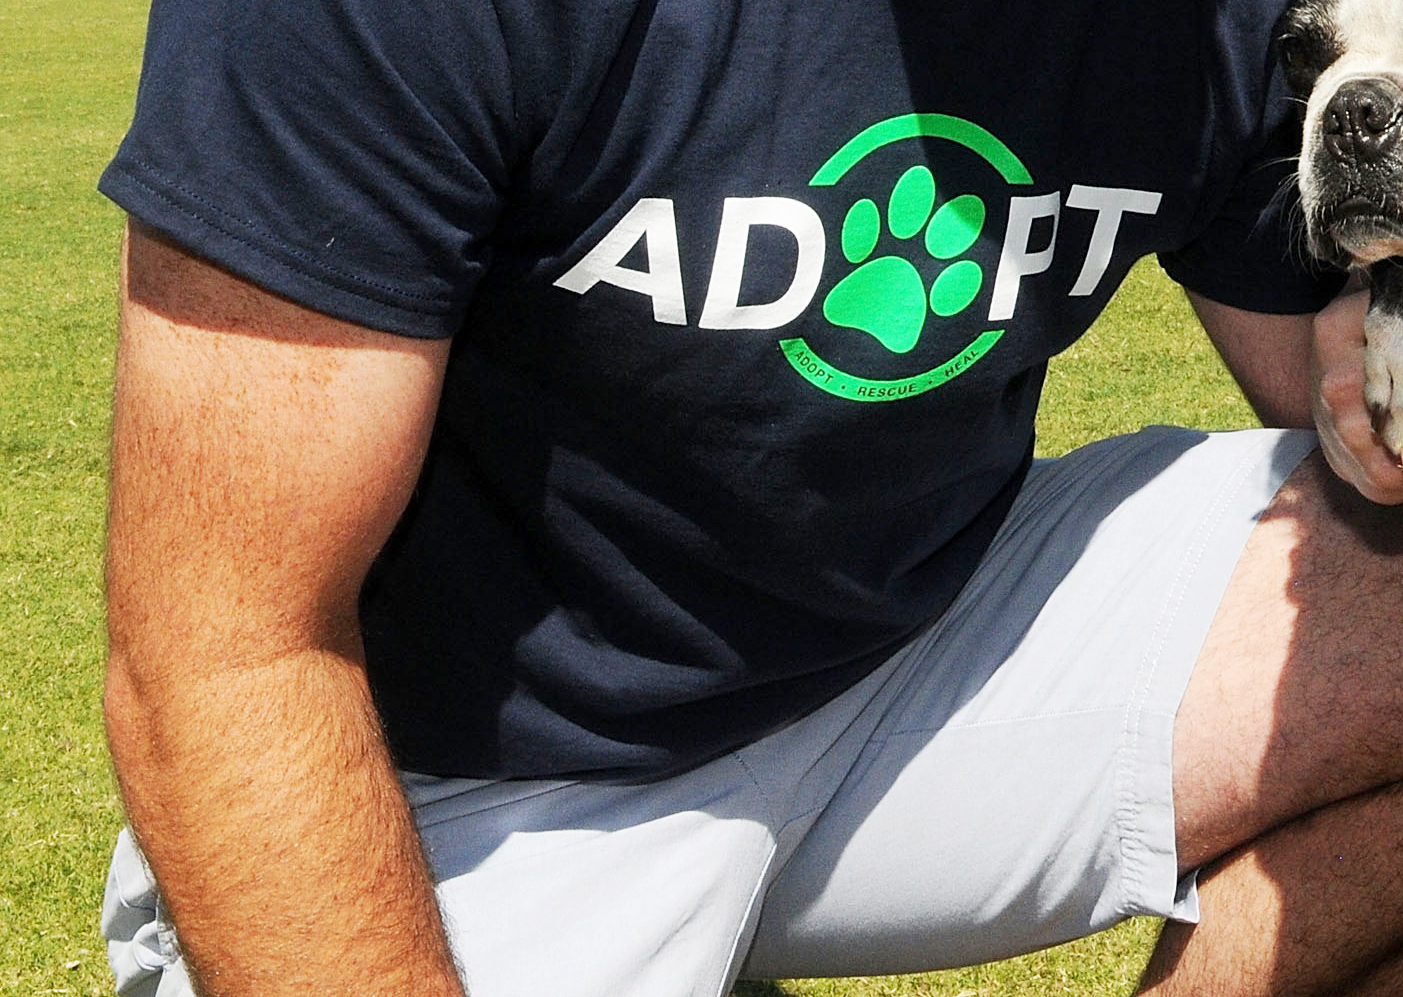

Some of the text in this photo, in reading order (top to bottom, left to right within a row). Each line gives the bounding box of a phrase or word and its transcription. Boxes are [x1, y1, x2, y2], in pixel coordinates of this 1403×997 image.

[793, 349, 980, 398] ADOPT RESCUE HEAL
